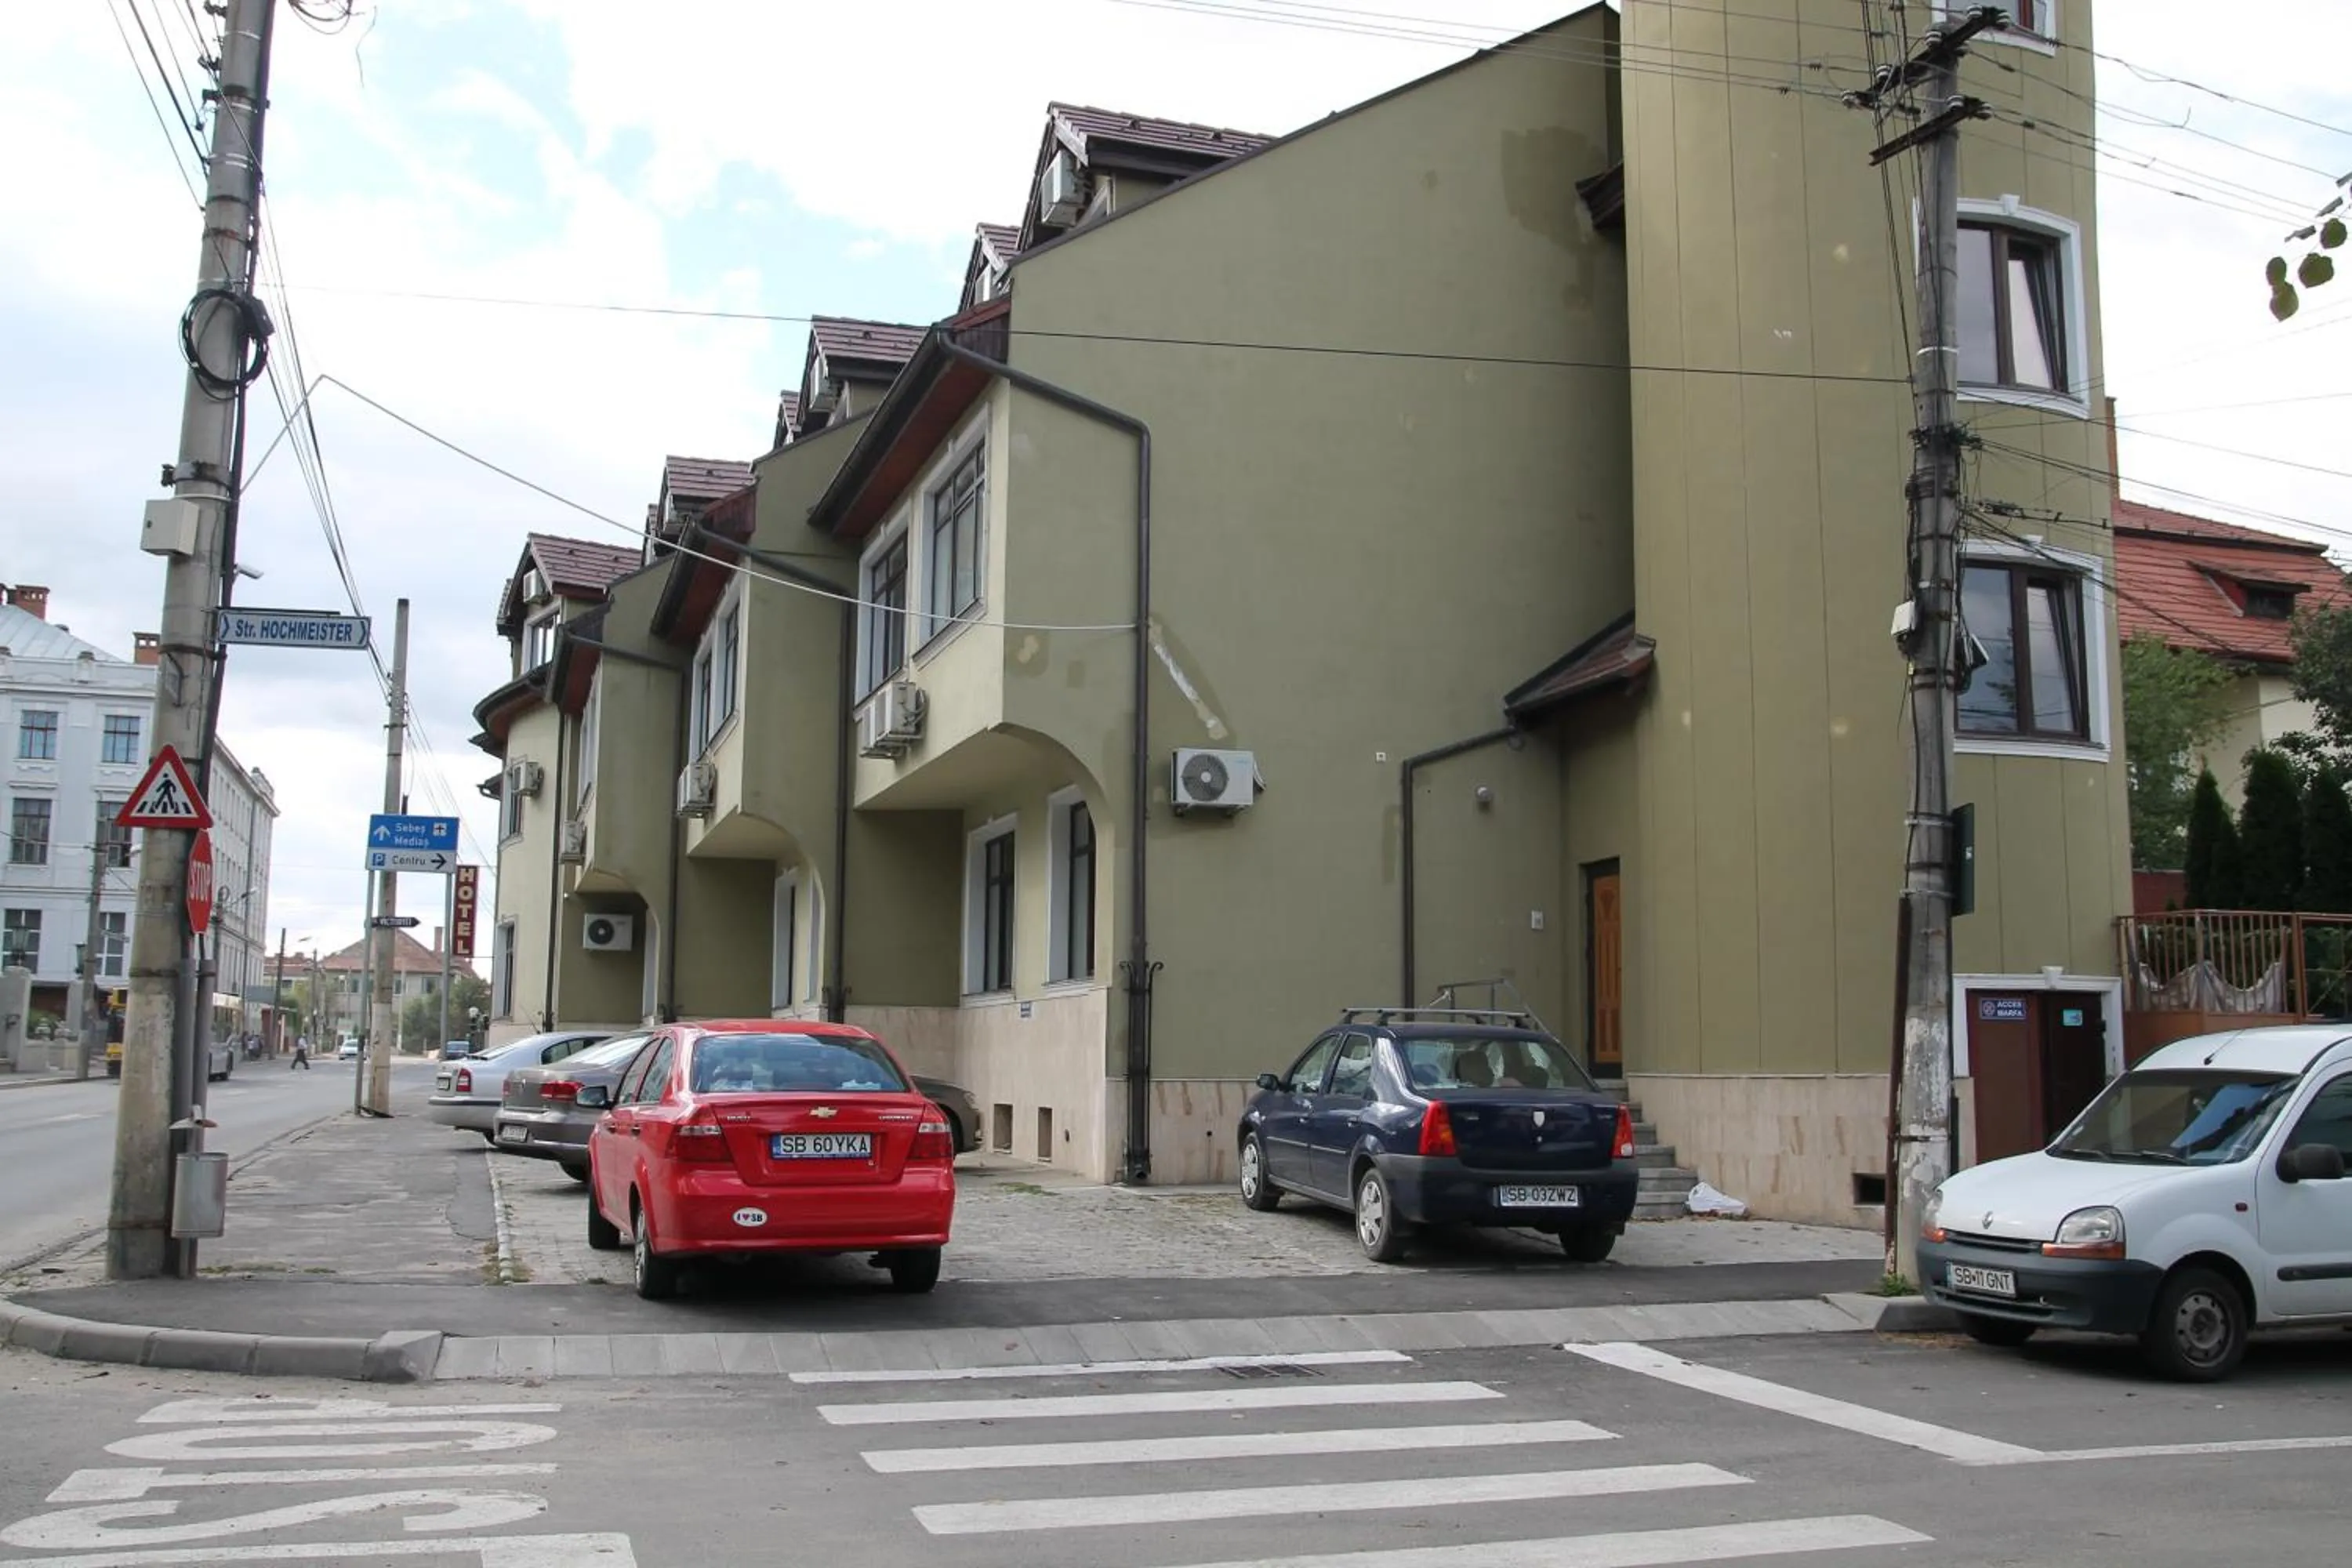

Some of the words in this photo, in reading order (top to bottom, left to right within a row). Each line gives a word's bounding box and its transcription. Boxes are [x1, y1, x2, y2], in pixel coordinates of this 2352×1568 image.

[235, 619, 256, 637] Str.
[260, 619, 352, 642] HOCHMEISTER
[392, 855, 426, 866] Centru
[191, 860, 211, 902] STOP
[457, 868, 474, 955] HOTEL
[782, 1137, 807, 1152] SB
[1508, 1188, 1526, 1202] SB
[1955, 1268, 1971, 1285] SB
[0, 1397, 563, 1549] STOP
